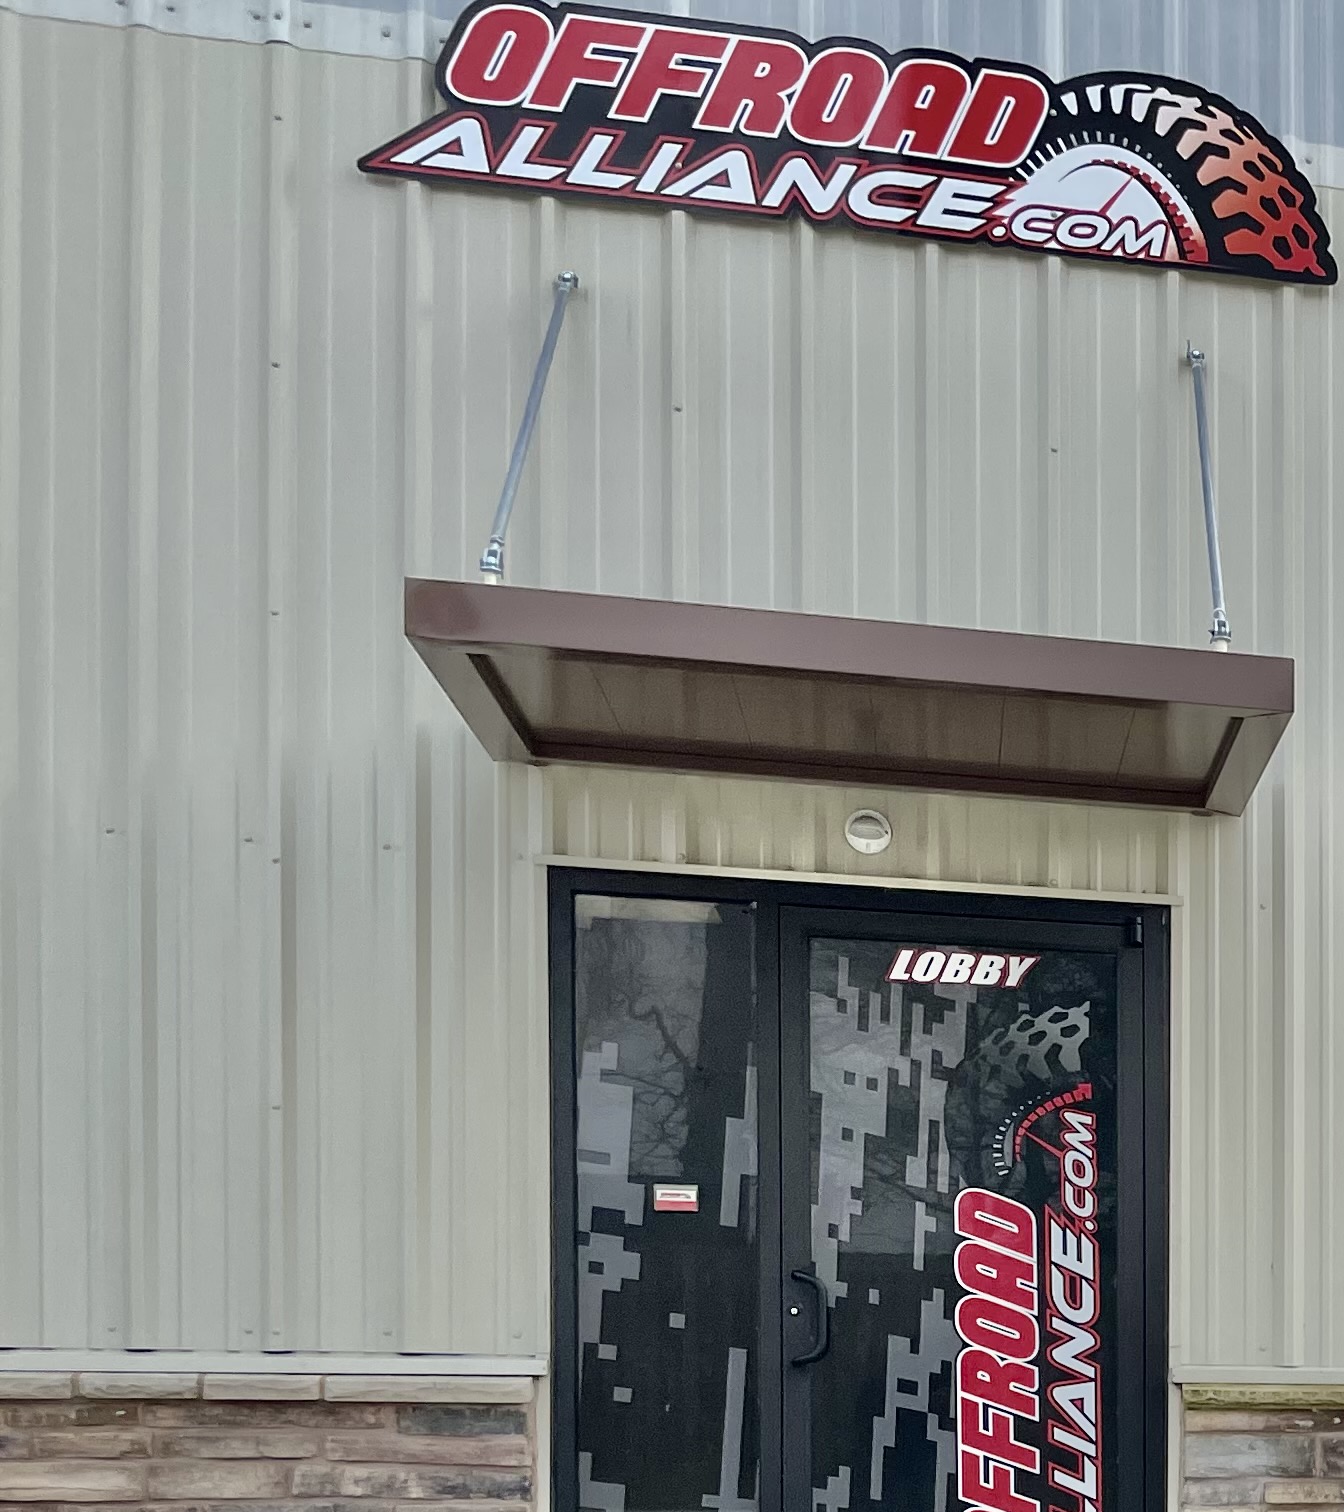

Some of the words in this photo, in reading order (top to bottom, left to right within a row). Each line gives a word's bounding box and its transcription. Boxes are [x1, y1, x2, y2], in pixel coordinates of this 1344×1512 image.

[445, 3, 1049, 166] OFFROAD
[391, 115, 1168, 258] ALLIANCE.COM
[888, 948, 1040, 987] LOBBY
